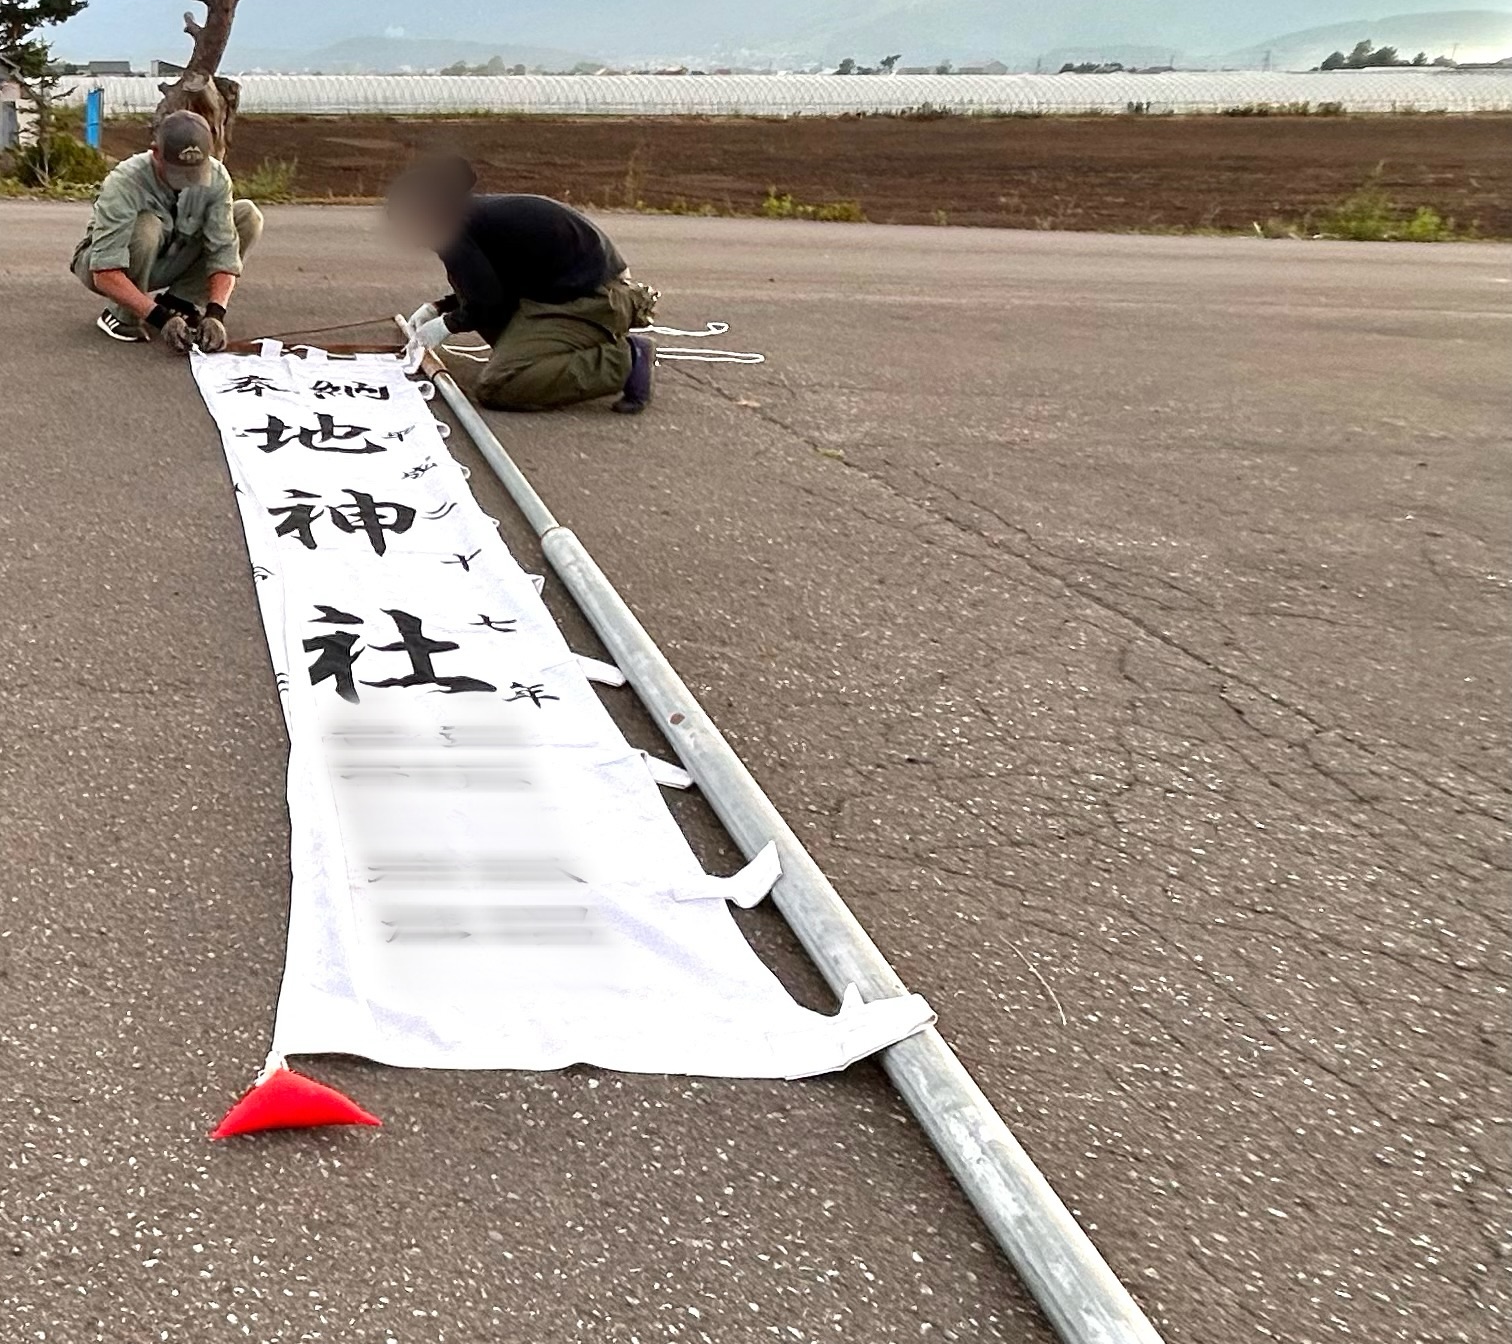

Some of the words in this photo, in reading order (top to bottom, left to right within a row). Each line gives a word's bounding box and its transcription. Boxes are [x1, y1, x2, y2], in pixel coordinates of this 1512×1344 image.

[215, 375, 390, 401] 奉納
[244, 412, 497, 705] 地神社
